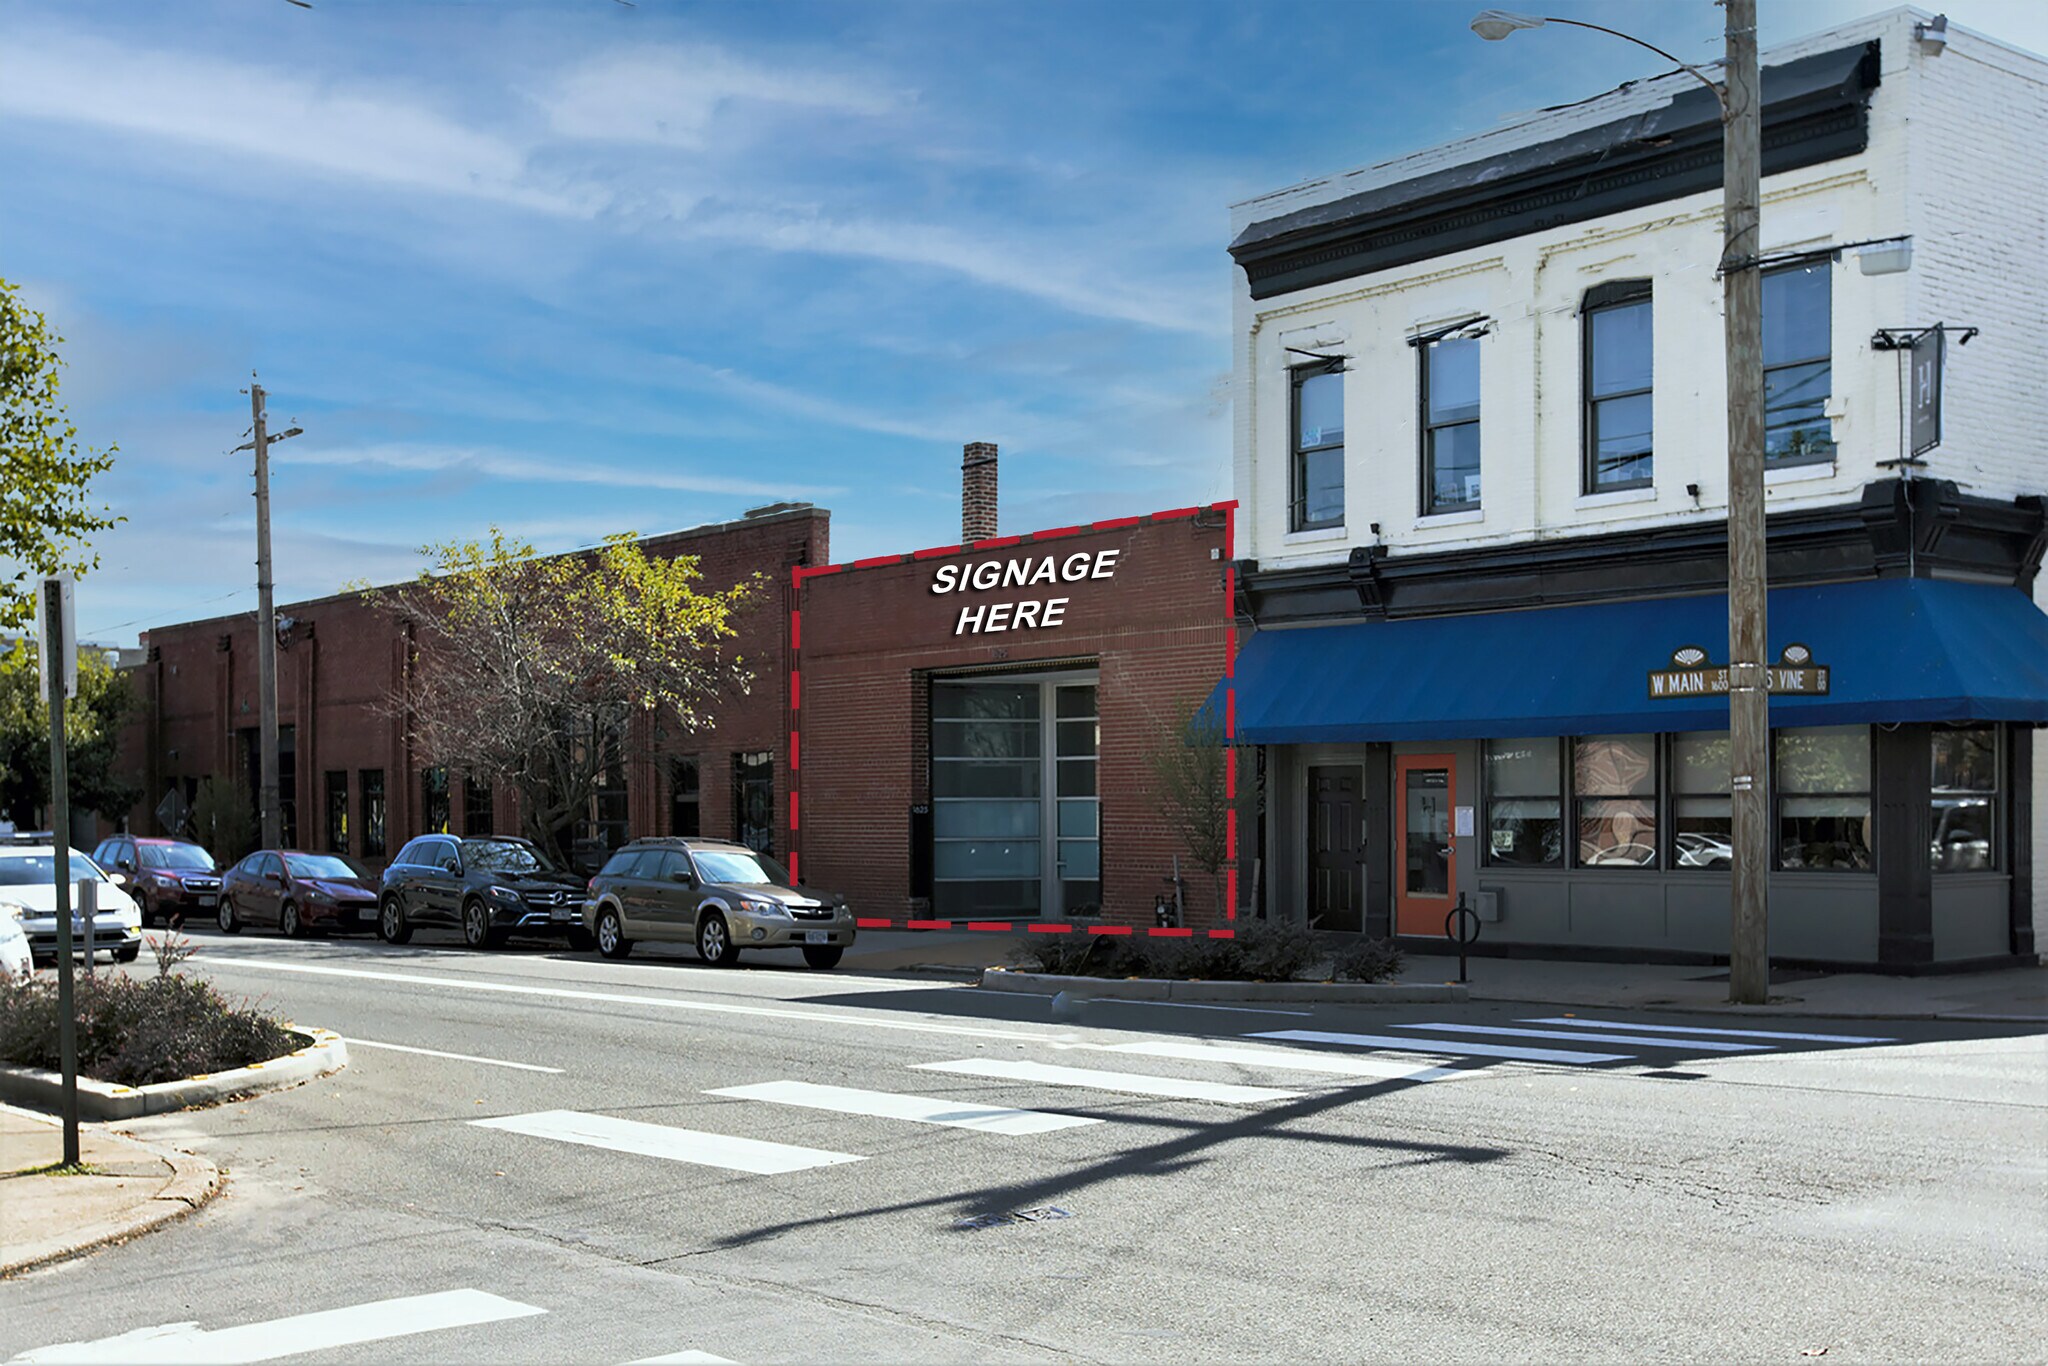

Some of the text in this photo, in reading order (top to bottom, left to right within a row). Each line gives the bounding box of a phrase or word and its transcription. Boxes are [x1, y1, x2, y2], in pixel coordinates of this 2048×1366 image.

[1652, 672, 1704, 694] W MAIN
[1718, 669, 1729, 680] ST
[1766, 670, 1804, 689] S VINE
